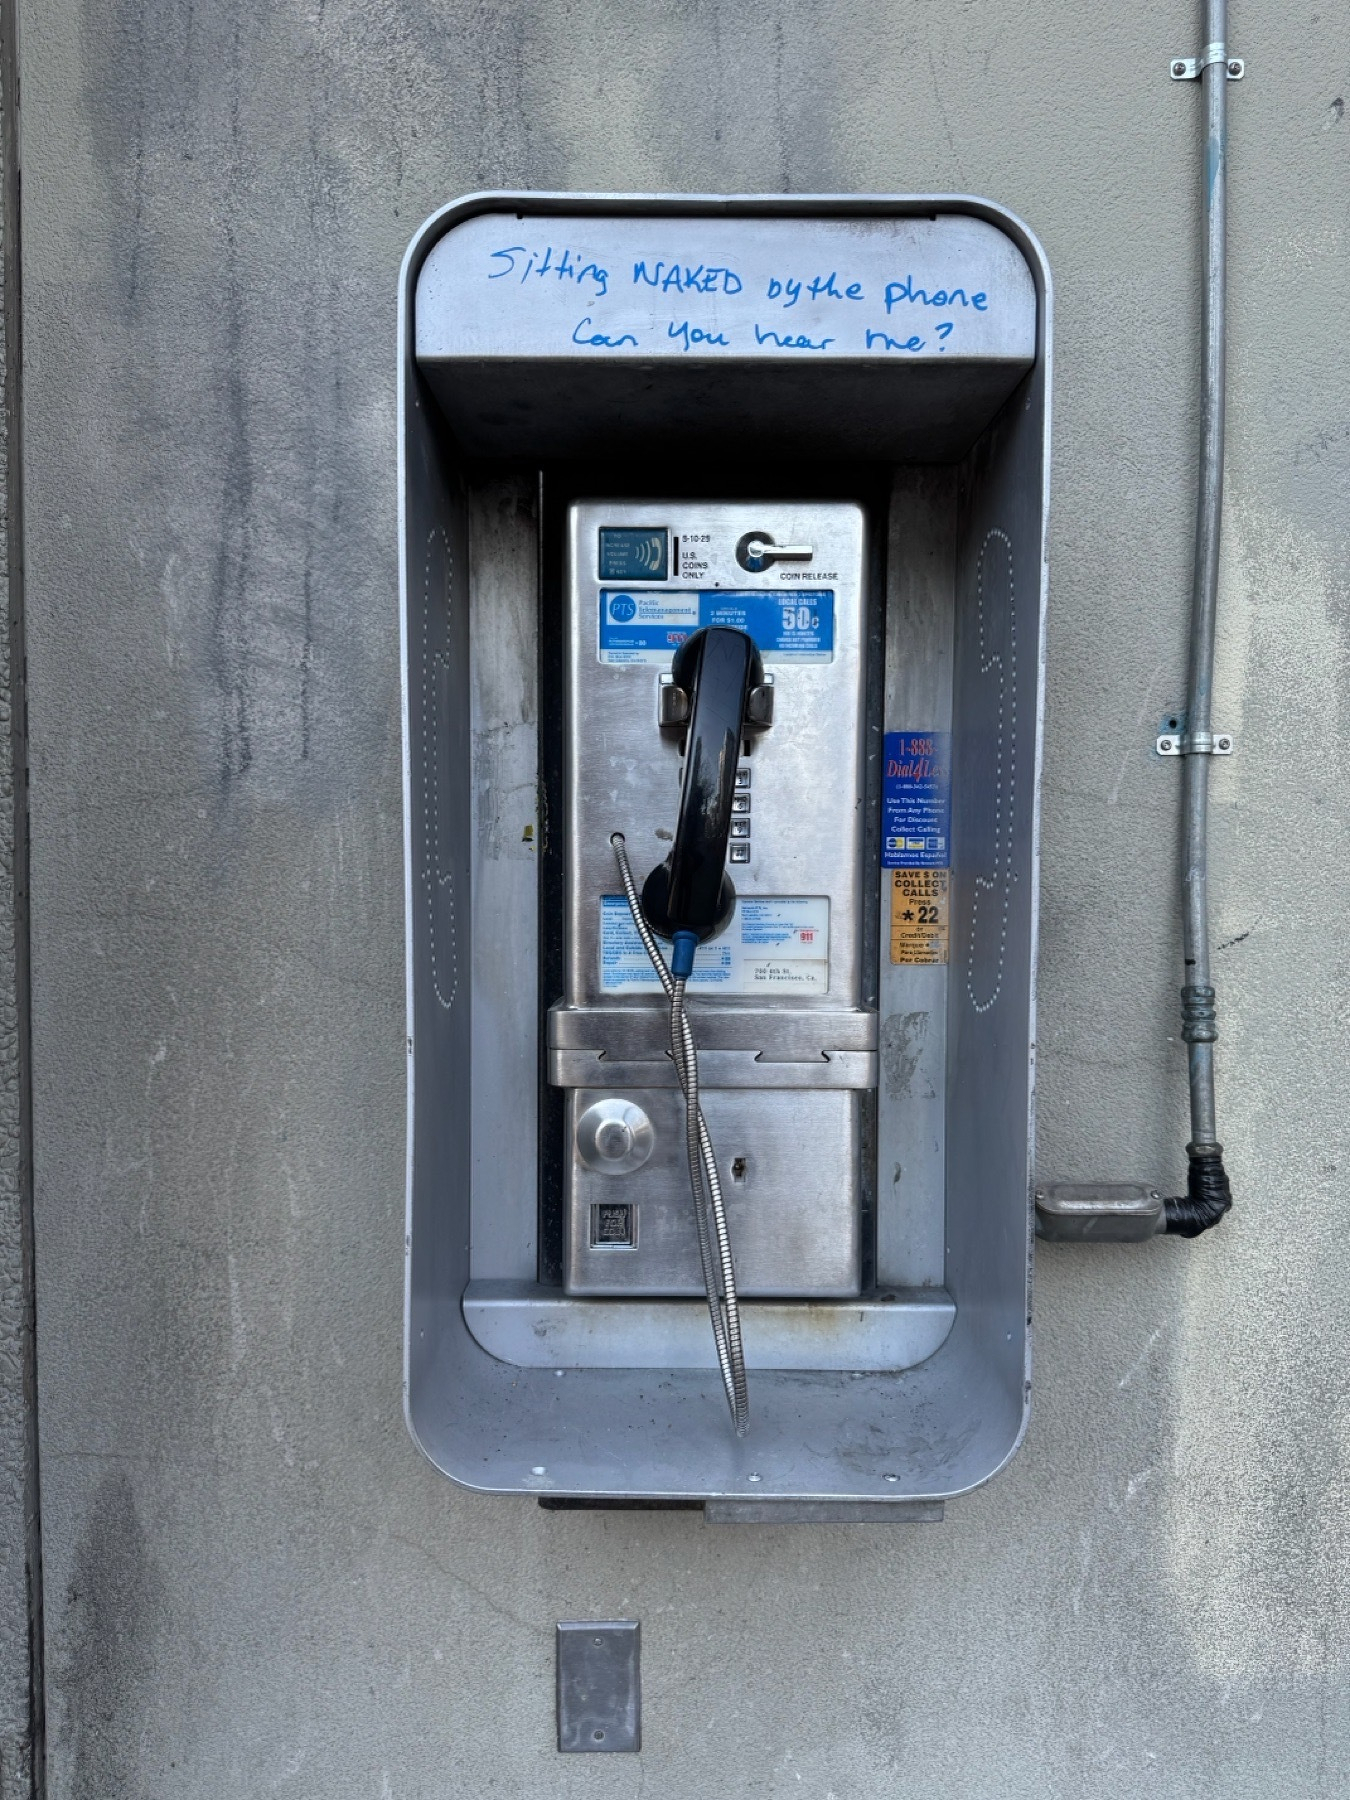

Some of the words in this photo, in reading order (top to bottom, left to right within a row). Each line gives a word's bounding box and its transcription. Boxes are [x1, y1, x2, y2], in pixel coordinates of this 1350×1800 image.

[488, 246, 609, 297] Sitting
[632, 260, 743, 295] NAKED
[884, 274, 988, 314] phone
[572, 317, 639, 348] Can
[865, 321, 954, 352] me?
[682, 562, 708, 570] COINS
[682, 572, 706, 580] ONLY
[780, 572, 800, 581] COIN
[802, 572, 839, 581] RELEASE
[612, 603, 634, 616] PTS
[907, 807, 922, 815] Any
[917, 826, 941, 834] Calling
[920, 850, 948, 859] Español
[895, 870, 921, 878] SAVE
[932, 870, 946, 878] ON
[894, 879, 946, 888] COLLECT
[902, 889, 939, 897] CALLS
[800, 932, 813, 941] 911
